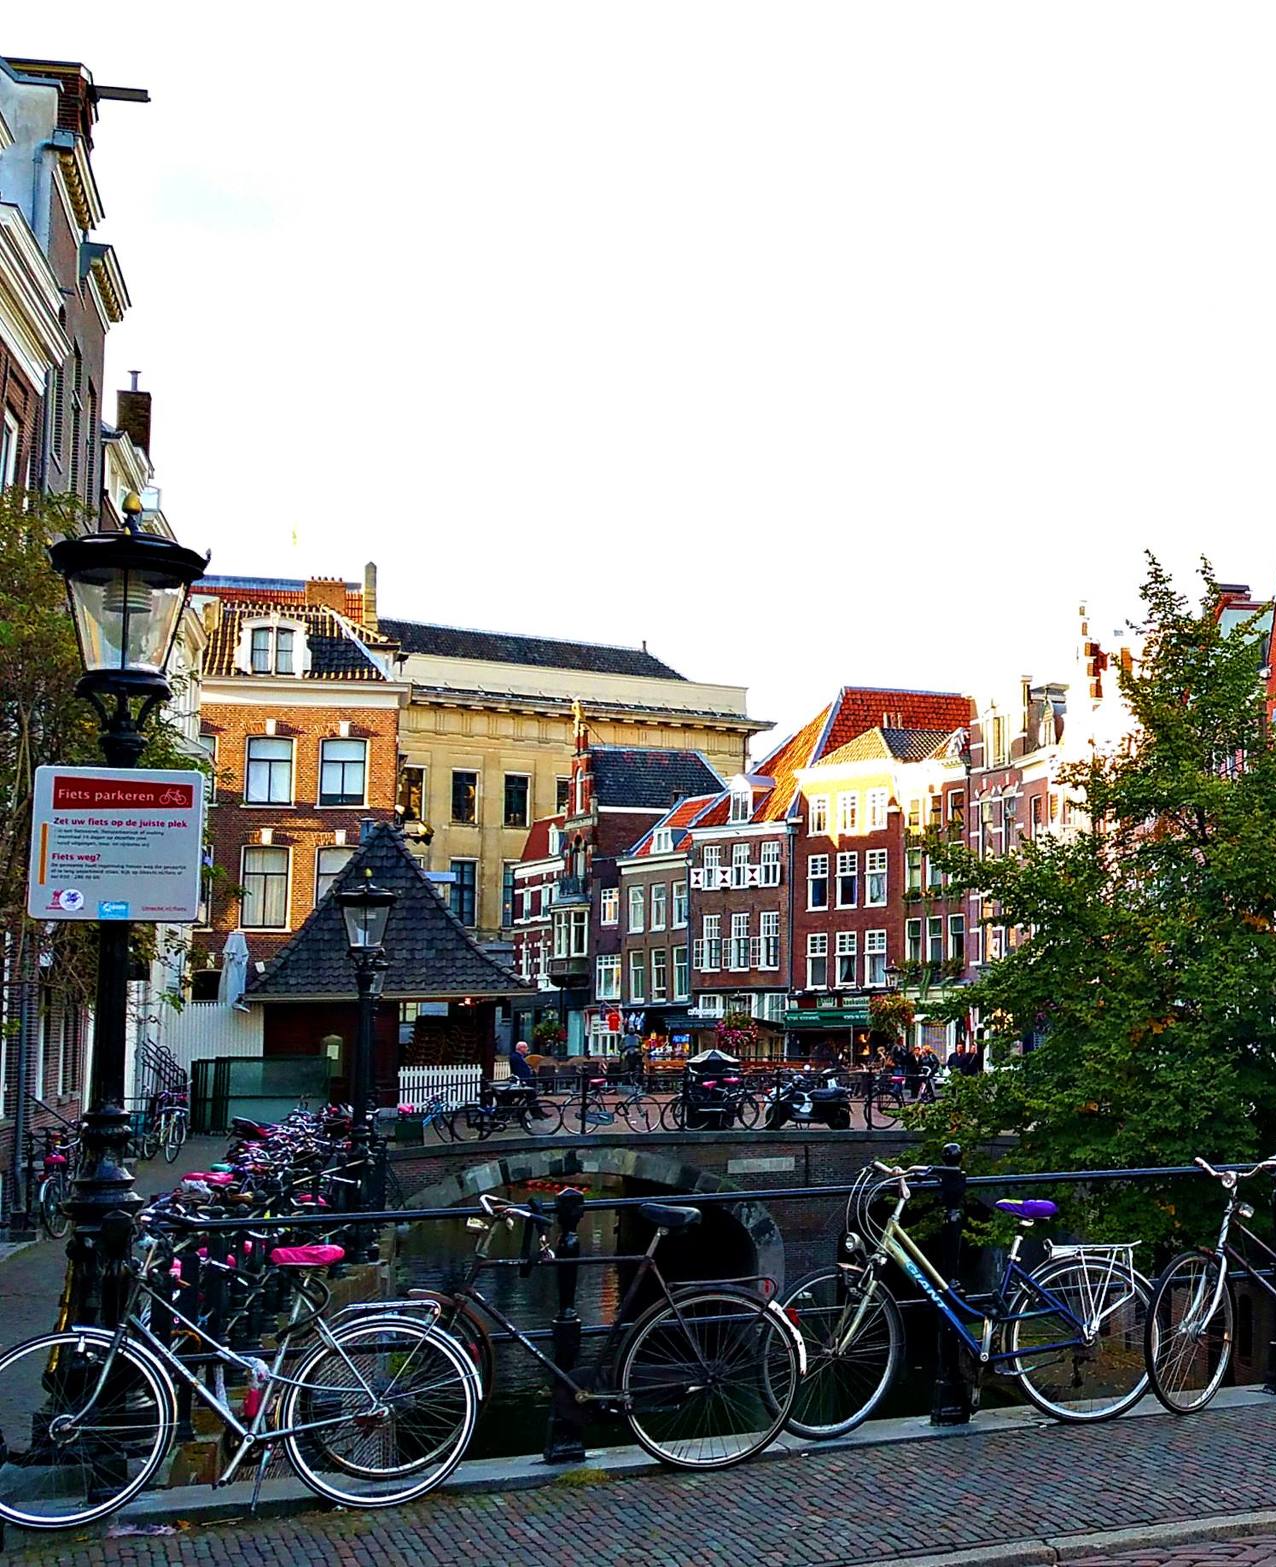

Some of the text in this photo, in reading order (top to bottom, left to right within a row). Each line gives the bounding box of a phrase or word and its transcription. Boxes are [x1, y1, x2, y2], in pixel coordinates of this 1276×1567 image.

[58, 788, 155, 802] Fiets parkeren
[53, 817, 68, 825] Zet
[88, 817, 108, 826] fiets
[111, 819, 123, 828] op
[125, 818, 137, 827] de
[138, 818, 165, 828] juiste
[168, 819, 188, 829] plek
[51, 852, 101, 862] Fiets weg?
[905, 1261, 949, 1311] GIANT
